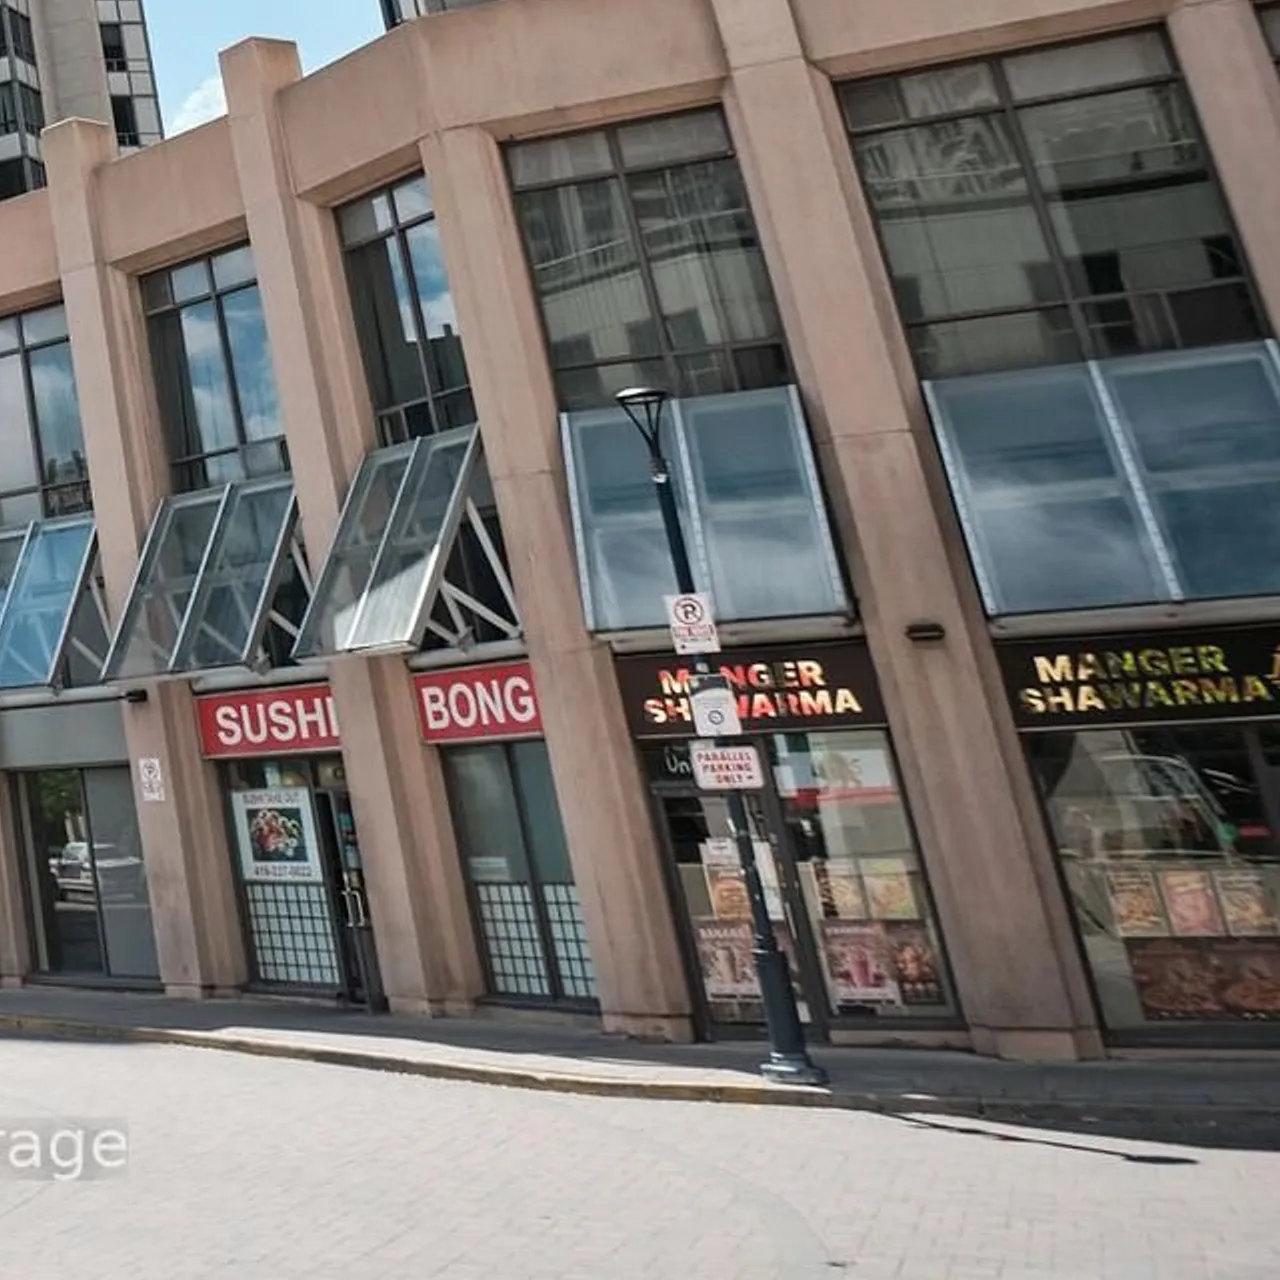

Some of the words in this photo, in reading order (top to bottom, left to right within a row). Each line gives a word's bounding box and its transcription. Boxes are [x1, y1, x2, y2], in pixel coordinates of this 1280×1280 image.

[659, 660, 826, 695] MNGER
[1033, 645, 1229, 683] MANGER
[421, 676, 536, 729] BONG
[644, 688, 862, 723] SHARMA
[1019, 675, 1274, 713] SHAWARMA
[216, 696, 339, 745] SUSHI
[702, 763, 753, 773] PARKING
